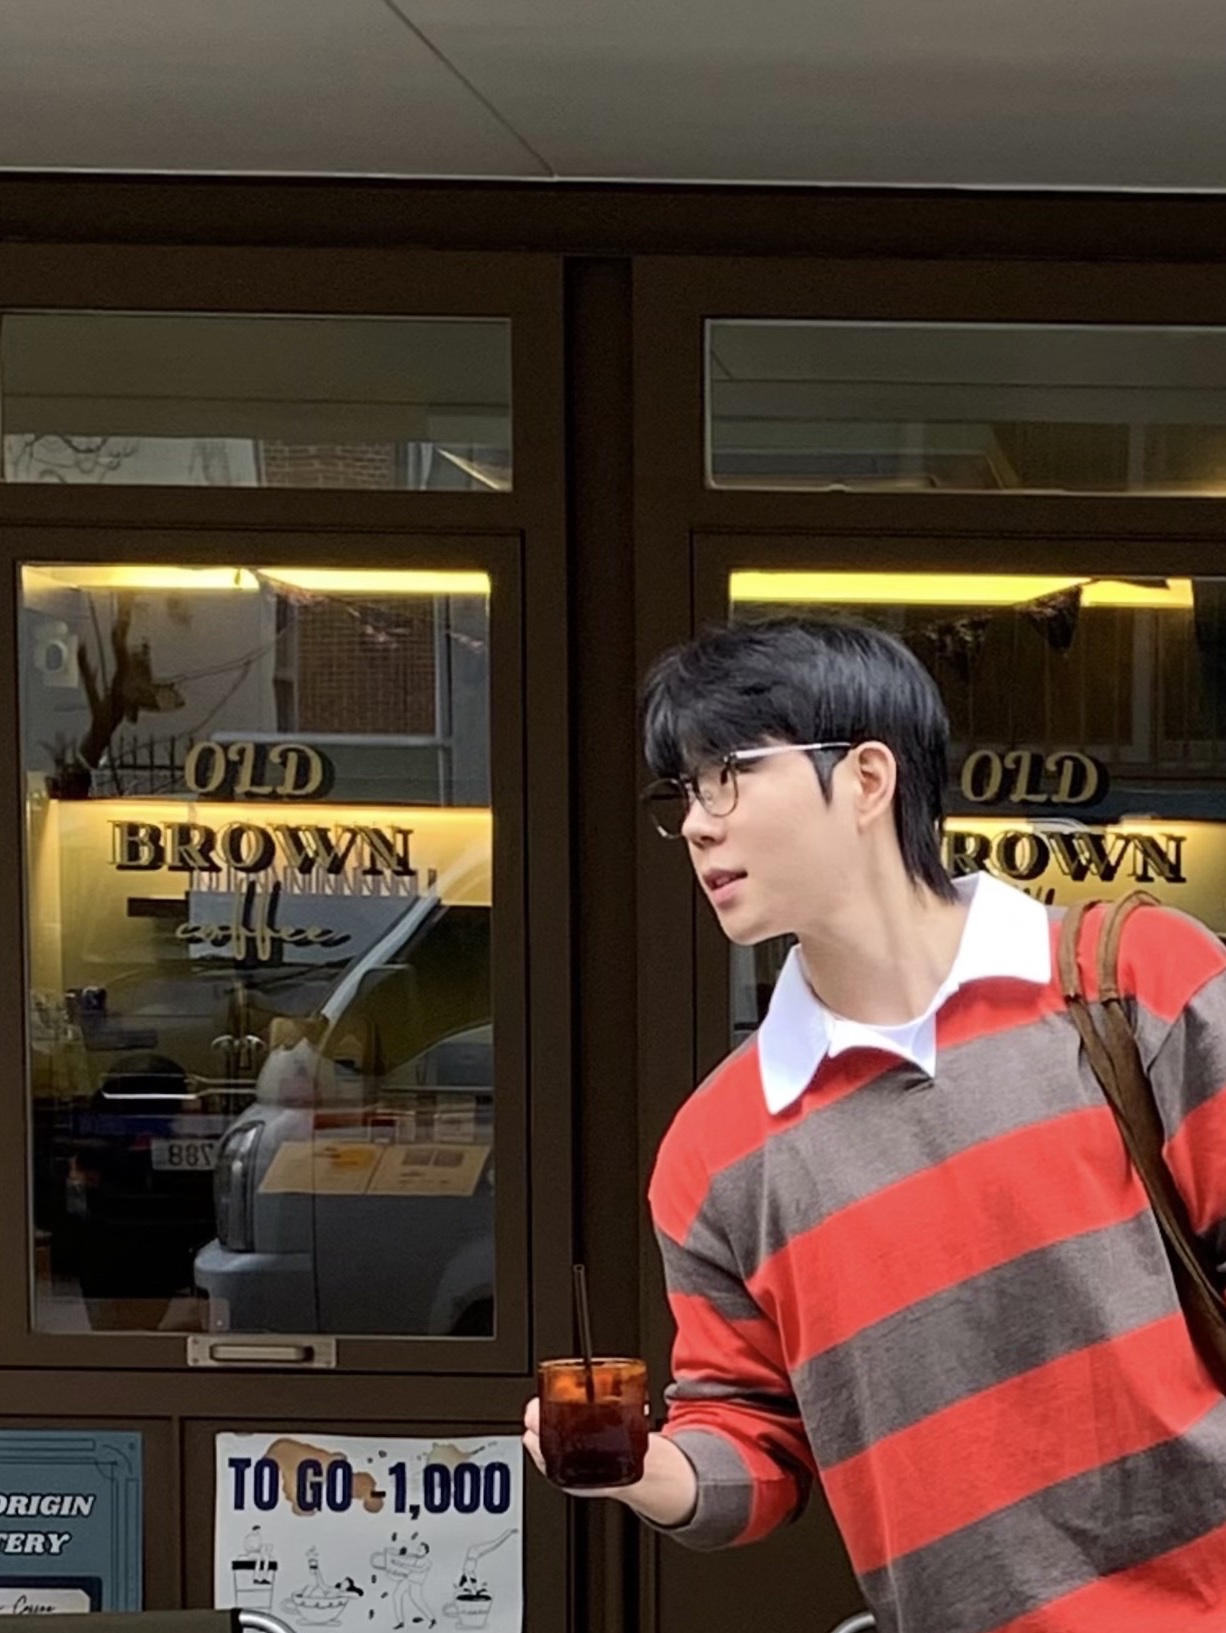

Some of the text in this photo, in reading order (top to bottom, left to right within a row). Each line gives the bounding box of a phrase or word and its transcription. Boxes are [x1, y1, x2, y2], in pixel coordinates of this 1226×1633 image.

[185, 742, 334, 799] OLD
[961, 750, 1110, 806] OLD
[107, 819, 416, 876] BROWN
[946, 829, 1187, 883] ROWN
[175, 880, 352, 969] coffee
[228, 1457, 279, 1511] TO
[296, 1458, 353, 1512] GO
